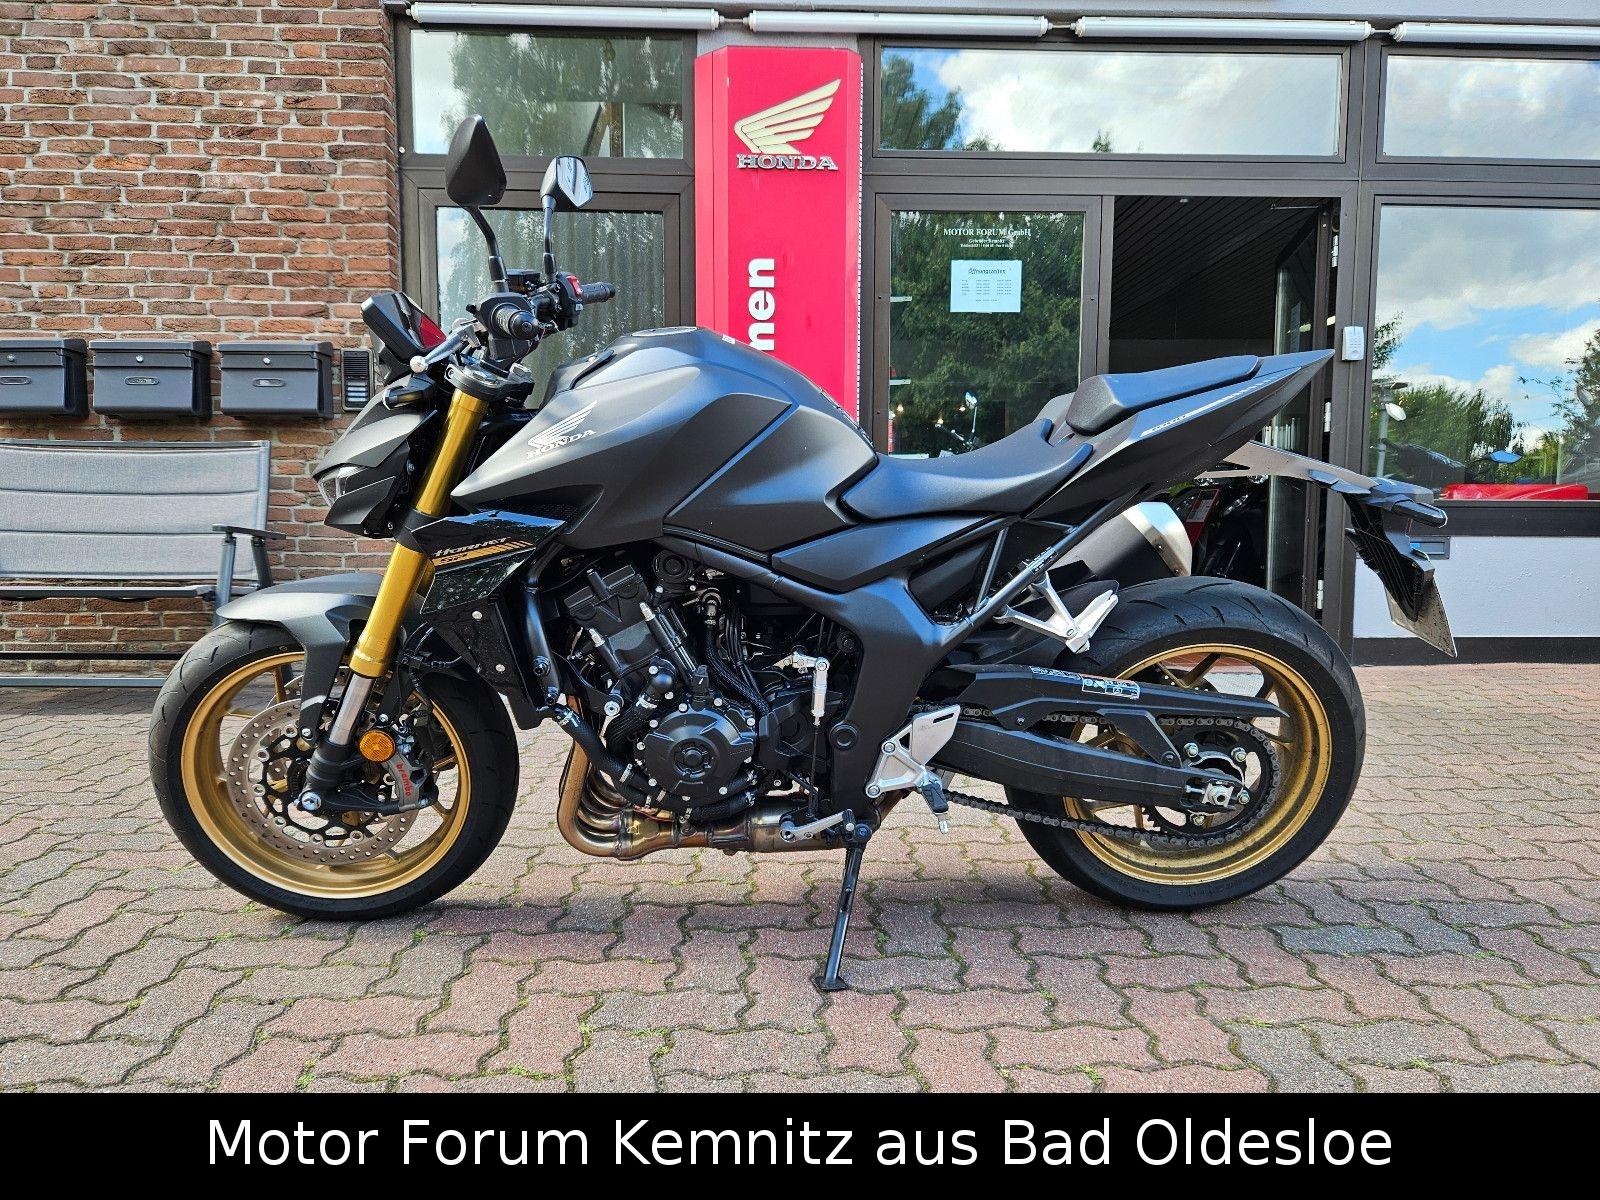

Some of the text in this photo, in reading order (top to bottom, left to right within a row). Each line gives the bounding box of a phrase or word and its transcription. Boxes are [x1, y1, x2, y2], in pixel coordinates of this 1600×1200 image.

[736, 153, 839, 170] HONDA
[943, 228, 974, 236] MOTOR
[976, 228, 1007, 236] FORUM
[526, 429, 596, 458] HONDA
[395, 763, 413, 797] brembo
